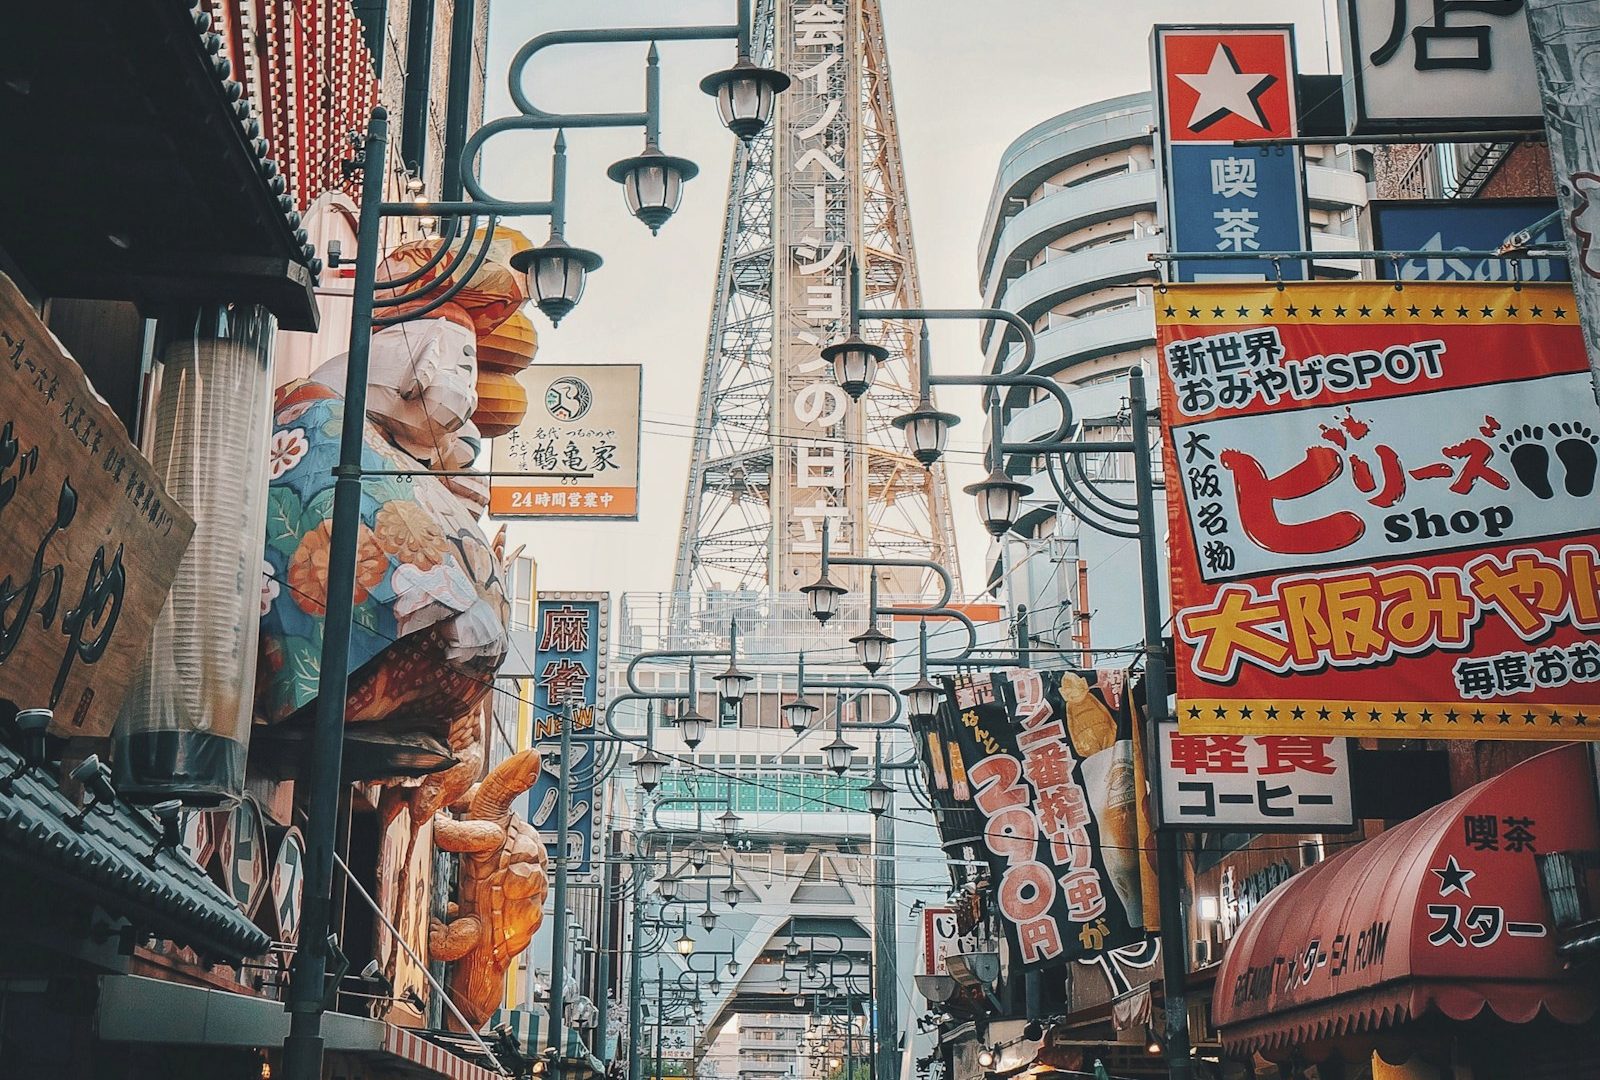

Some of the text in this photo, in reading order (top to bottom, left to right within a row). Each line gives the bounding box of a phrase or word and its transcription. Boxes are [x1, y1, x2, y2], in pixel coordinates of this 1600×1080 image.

[1209, 157, 1262, 252] 喫茶
[1169, 331, 1281, 380] 新世界
[1180, 343, 1445, 414] おみやげSPOT
[531, 439, 620, 472] 鶴亀家
[511, 491, 614, 508] 24時間営業中
[1183, 430, 1236, 573] 大阪名物
[1220, 408, 1511, 555] ビリーズ
[538, 606, 590, 706] 麻雀
[1170, 736, 1338, 776] 軽食
[1177, 780, 1334, 818] コーヒー
[1464, 815, 1537, 853] 喫茶
[1427, 903, 1548, 948] スター
